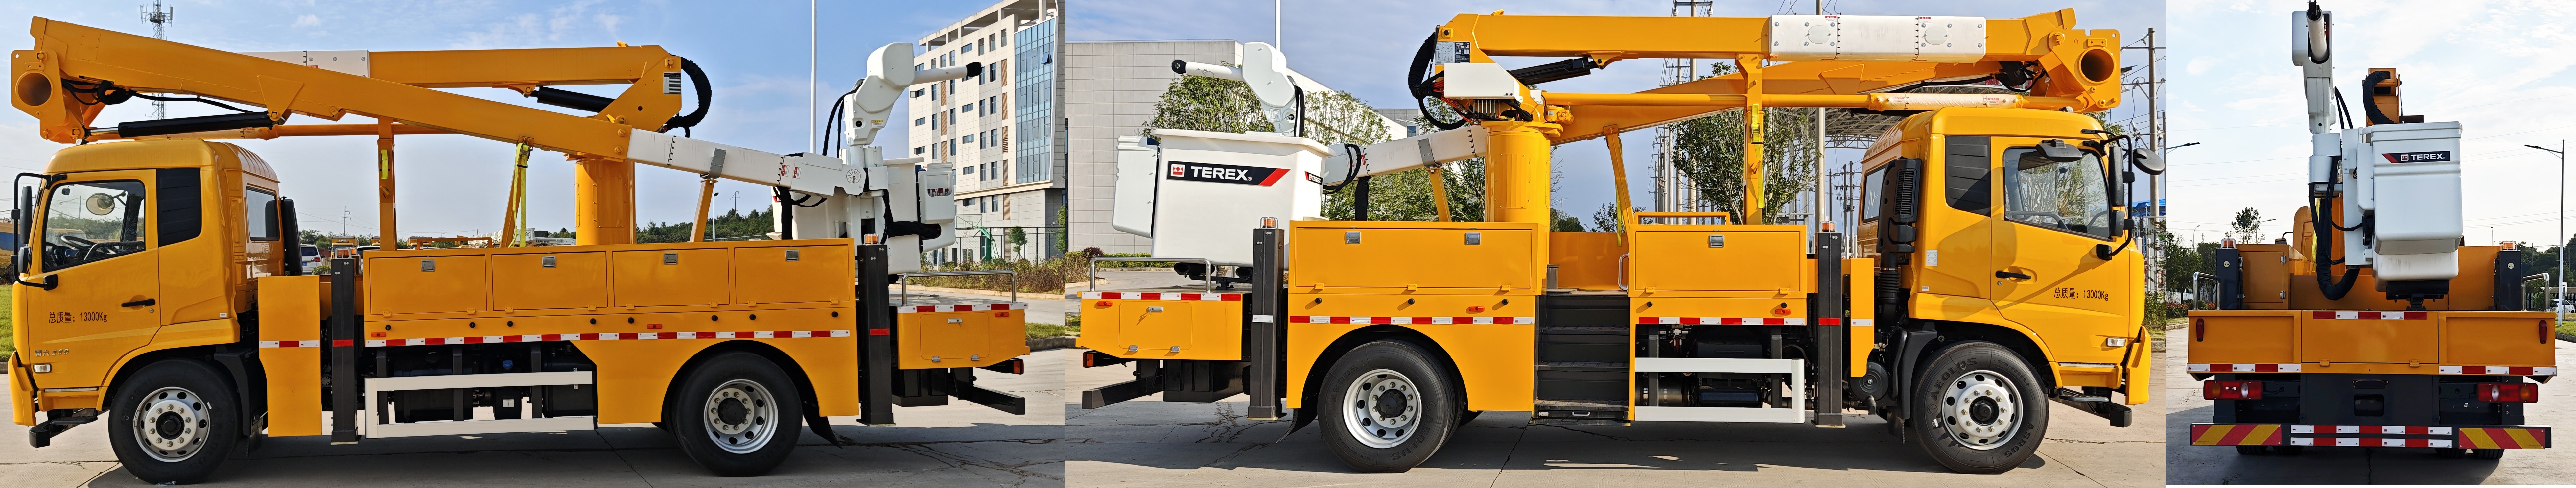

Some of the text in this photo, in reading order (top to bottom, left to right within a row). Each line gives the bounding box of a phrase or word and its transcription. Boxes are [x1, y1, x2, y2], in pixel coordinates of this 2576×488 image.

[1191, 166, 1248, 181] TEREX
[1930, 358, 1977, 401] AEOLUS
[1391, 414, 1433, 461] AEOLUS
